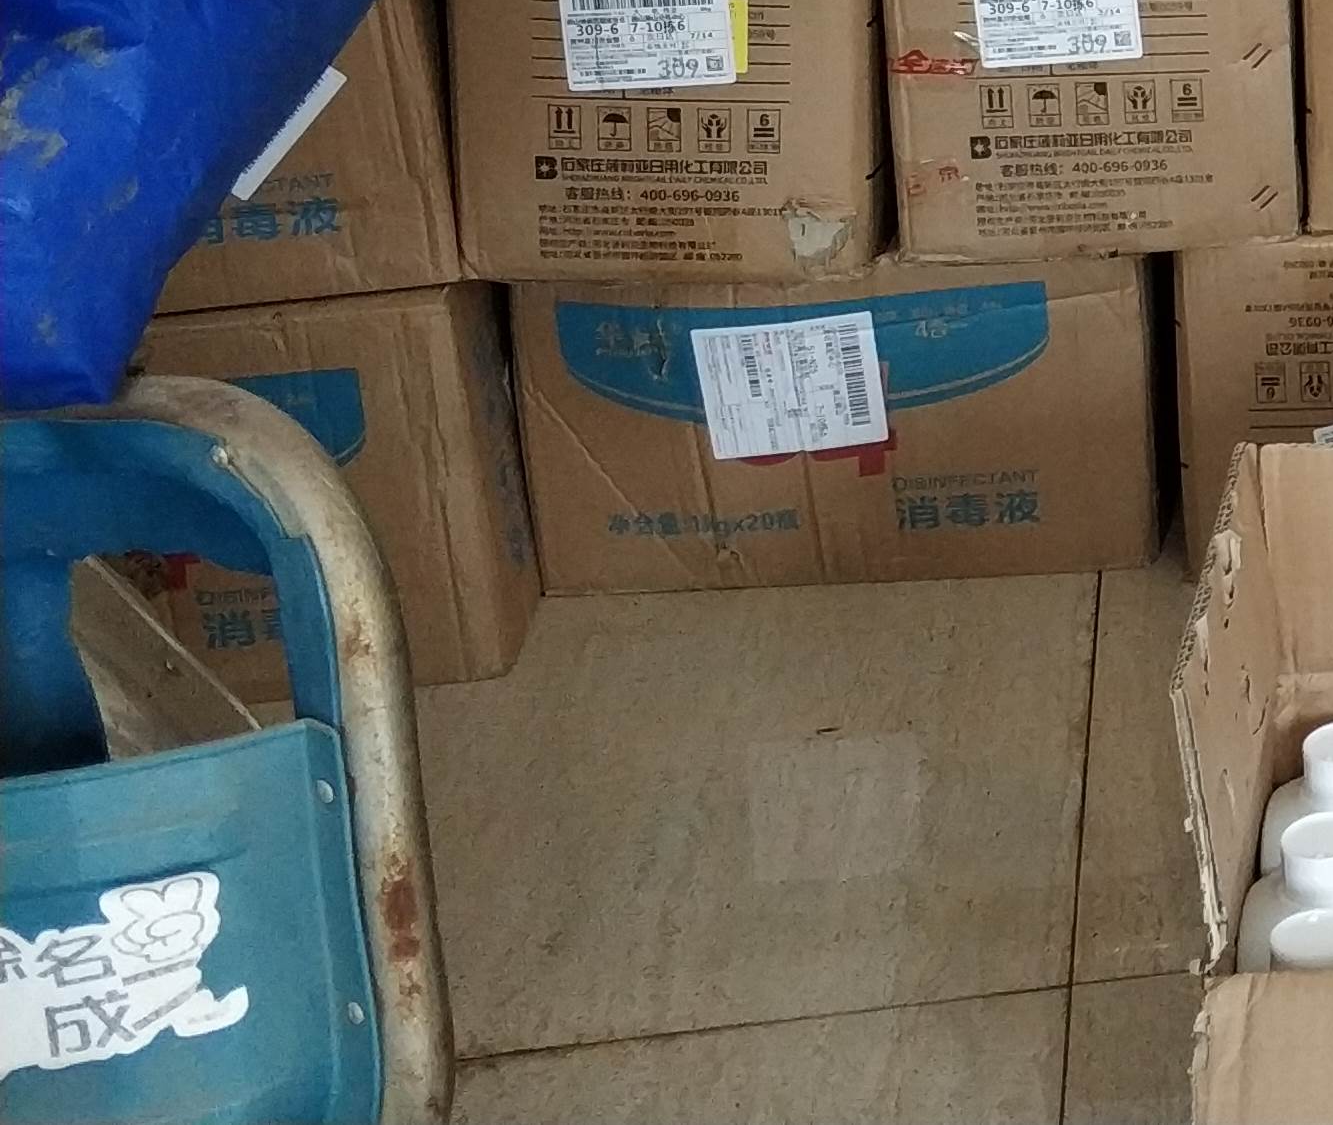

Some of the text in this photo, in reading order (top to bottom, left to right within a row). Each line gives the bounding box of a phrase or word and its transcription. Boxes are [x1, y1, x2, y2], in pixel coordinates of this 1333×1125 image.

[989, 2, 1030, 15] 309-6
[577, 24, 619, 36] 309-6
[657, 55, 699, 78] 309
[1181, 83, 1193, 97] 6
[1071, 159, 1169, 174] 400-696-0936
[640, 189, 740, 202] 400-696-0936
[898, 490, 1041, 532] 消毒液
